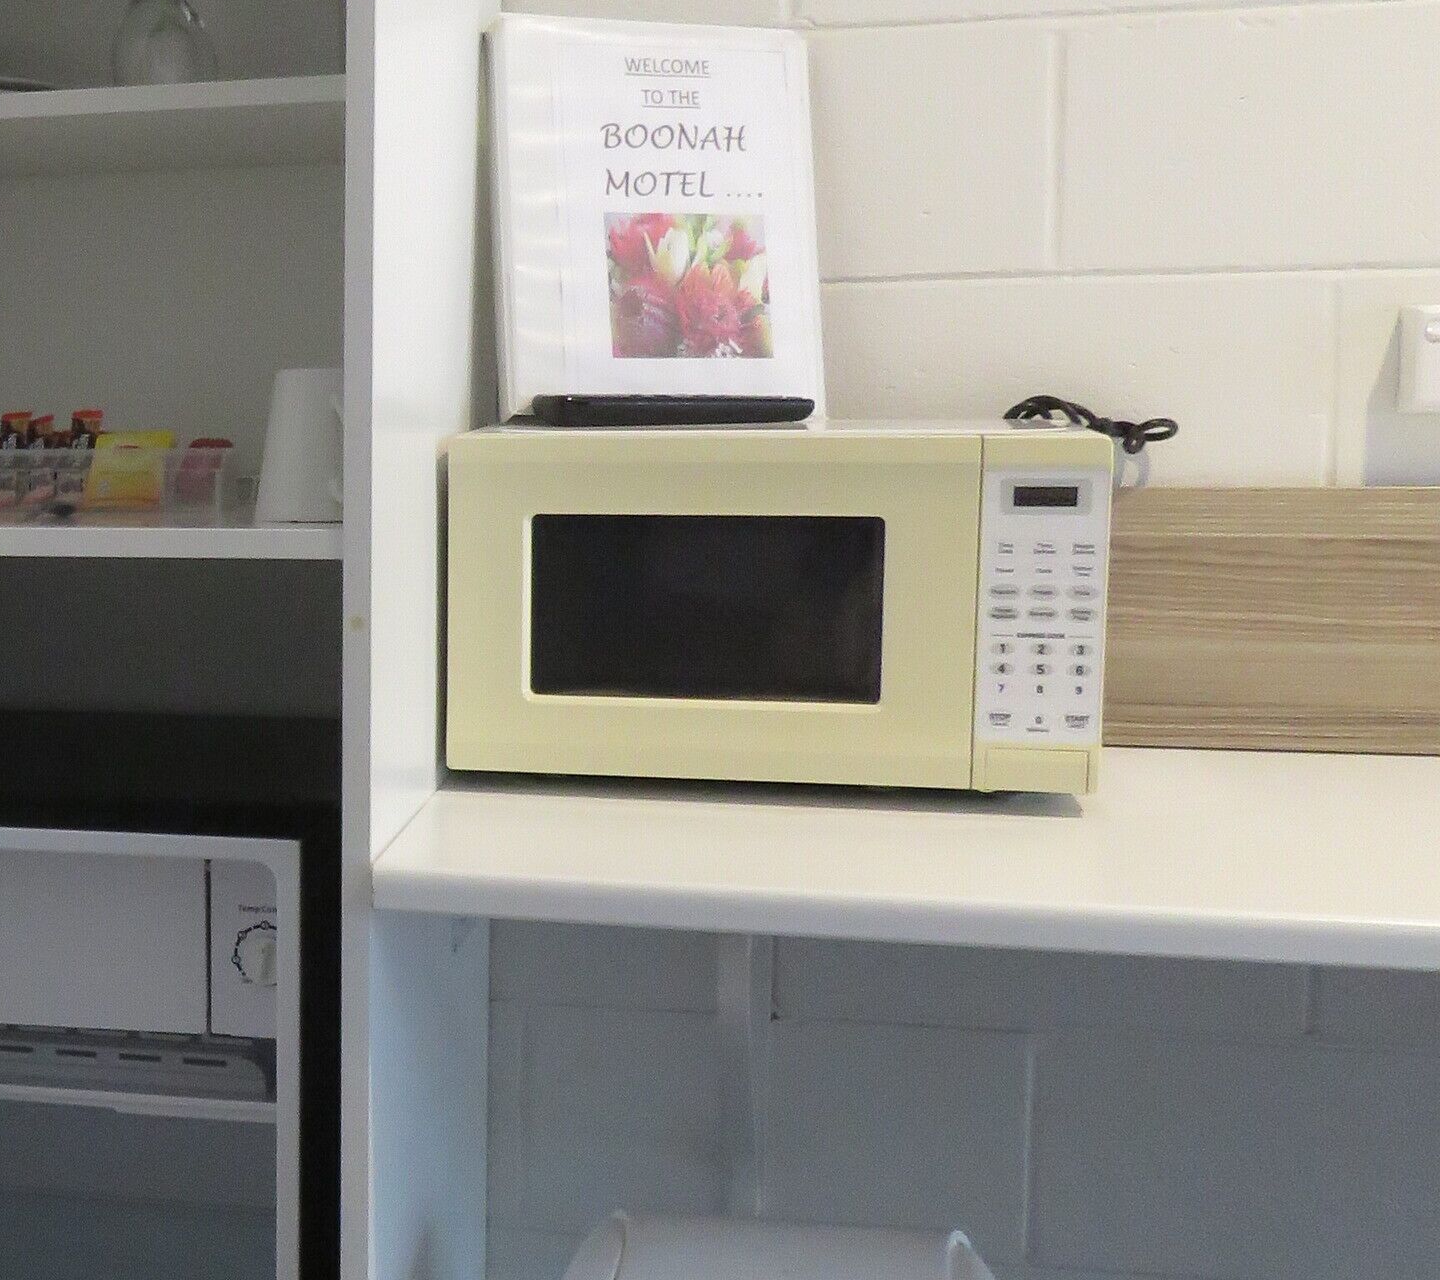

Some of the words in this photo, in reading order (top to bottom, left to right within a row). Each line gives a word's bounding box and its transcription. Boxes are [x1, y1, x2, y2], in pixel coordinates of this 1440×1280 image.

[624, 57, 710, 76] WELCOME
[641, 89, 663, 105] TO
[668, 90, 699, 106] THE
[600, 122, 747, 153] BOONAH
[605, 167, 715, 198] MOTEL
[999, 642, 1006, 654] 1
[1037, 643, 1046, 655] 2
[1076, 644, 1085, 656] 3
[997, 662, 1006, 674] 4
[1036, 663, 1045, 675] 5
[1075, 665, 1084, 676] 6
[997, 683, 1005, 693] 7
[1036, 684, 1044, 694] 8
